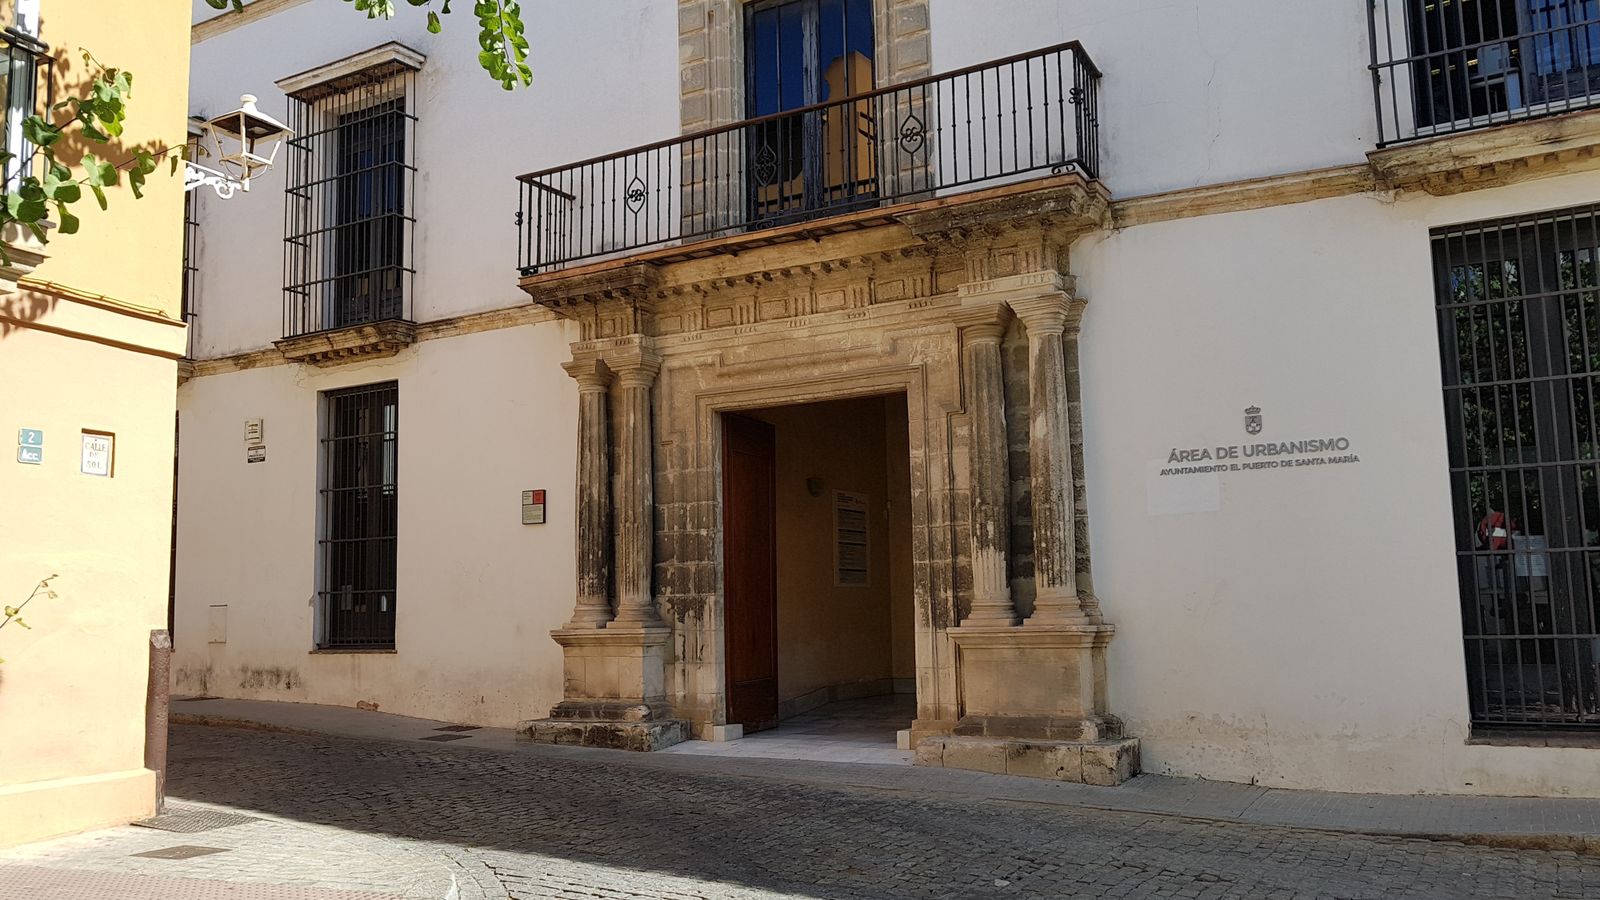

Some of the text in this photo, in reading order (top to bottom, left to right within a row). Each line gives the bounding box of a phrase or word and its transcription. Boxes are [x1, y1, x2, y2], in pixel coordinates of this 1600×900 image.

[28, 432, 34, 443] 2
[85, 442, 106, 452] CALLE
[1168, 437, 1350, 463] ÁREA DE URBANISMO
[86, 461, 102, 469] SOL
[1160, 464, 1228, 476] AYUNTAMIENTO
[1230, 463, 1241, 471] EL
[1243, 461, 1278, 470] PUERTO
[1295, 457, 1327, 466] SANTA
[1328, 454, 1360, 464] MARÍA
